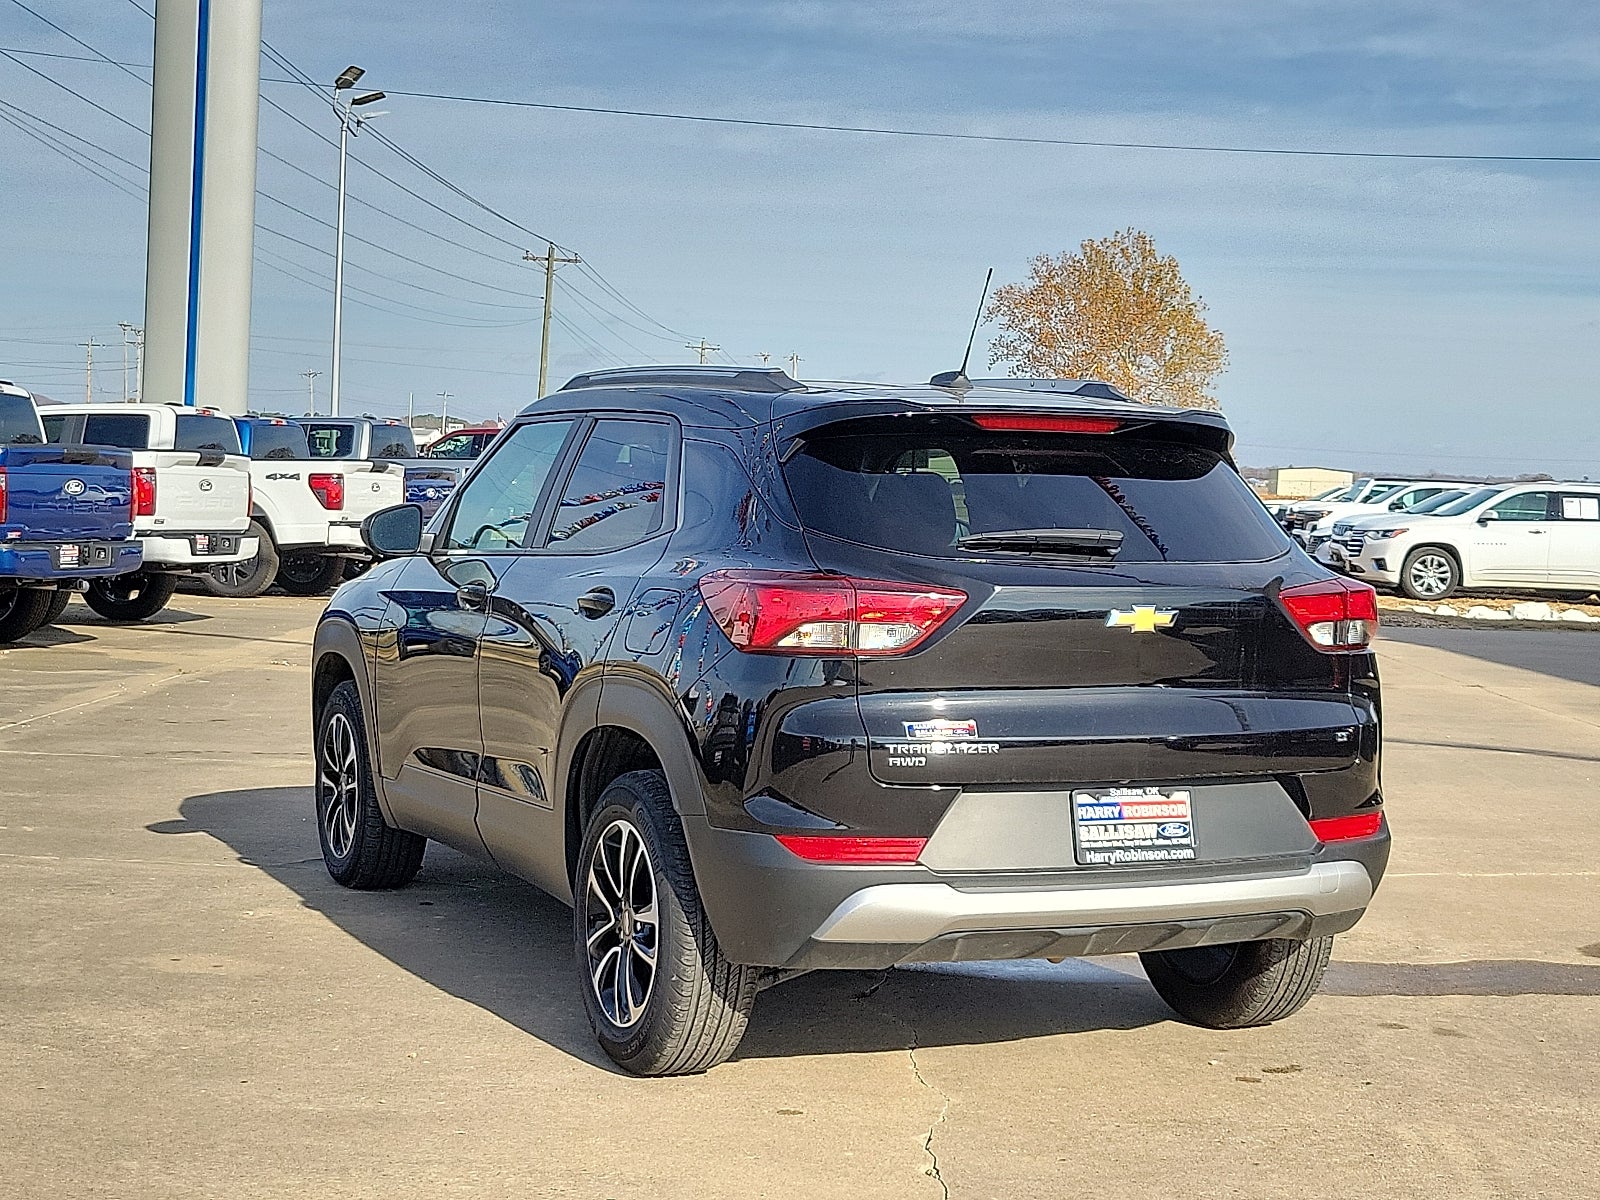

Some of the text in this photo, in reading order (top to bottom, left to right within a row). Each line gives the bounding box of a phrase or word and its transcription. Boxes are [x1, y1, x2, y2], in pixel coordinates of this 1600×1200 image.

[888, 757, 926, 767] AWD
[1147, 786, 1160, 796] OK
[1078, 804, 1187, 819] HARRY ROBINSON
[1080, 825, 1157, 841] SALLISAW
[1086, 848, 1195, 864] HarryRobinson.com
